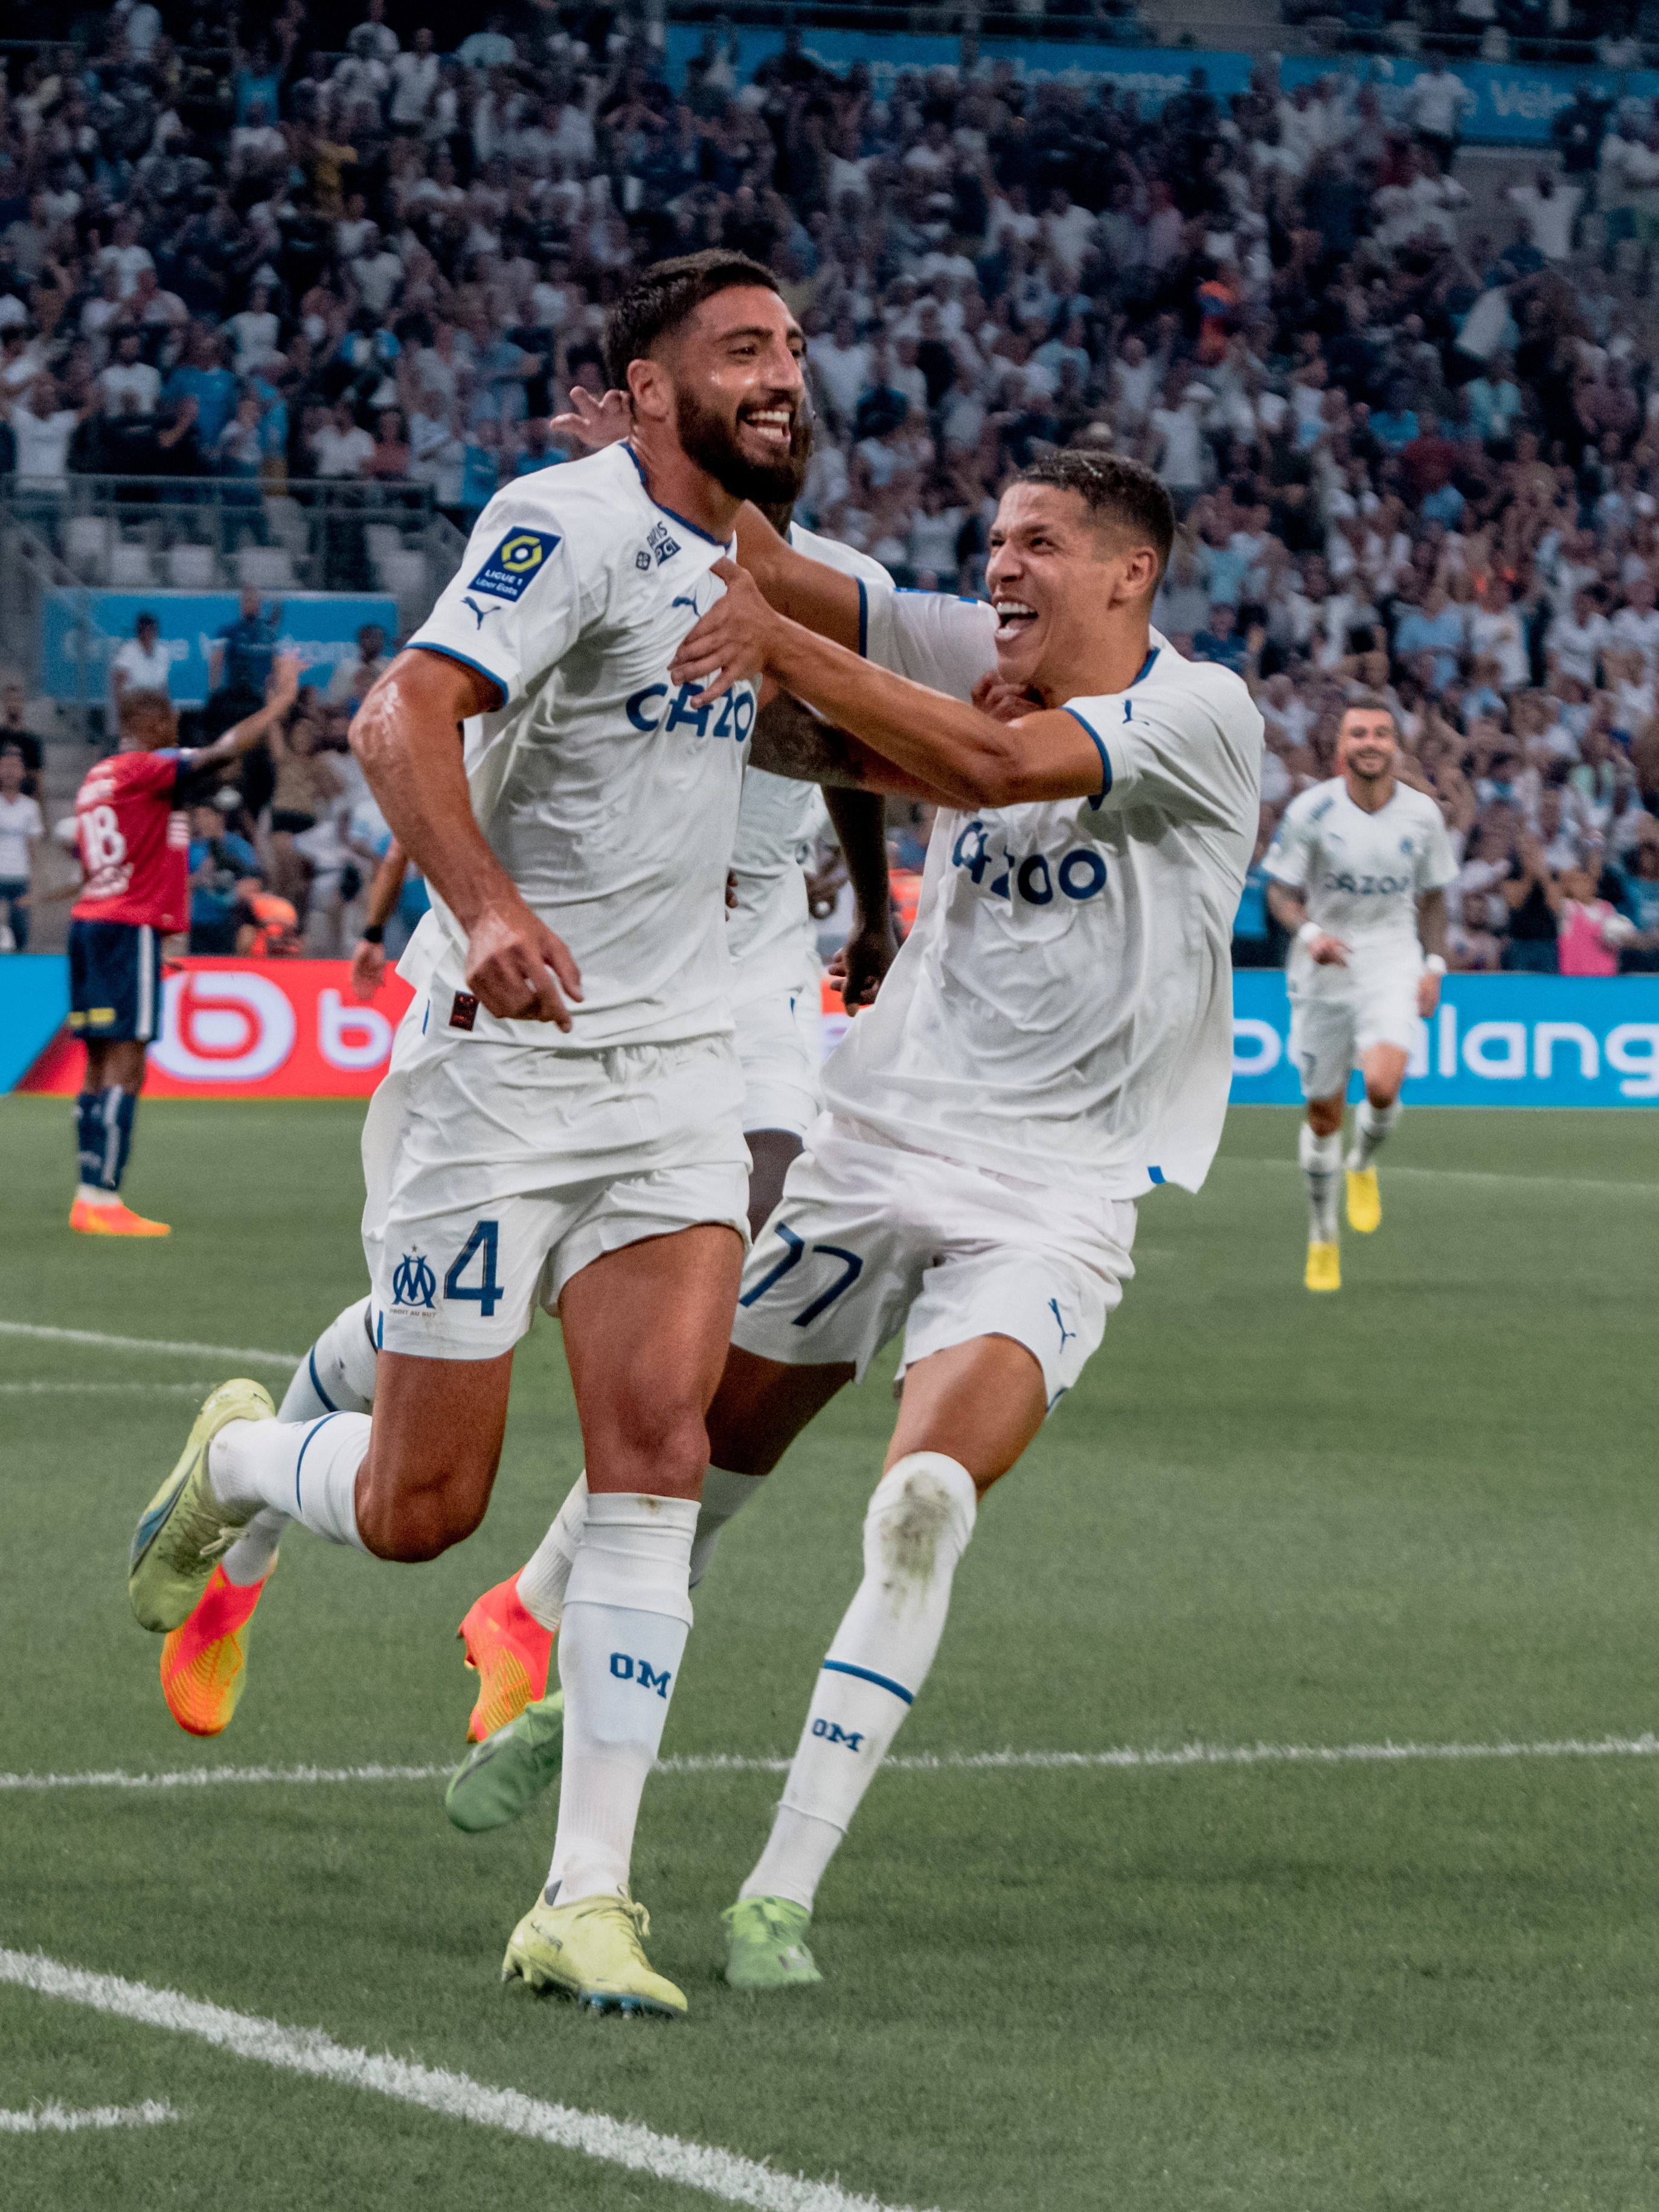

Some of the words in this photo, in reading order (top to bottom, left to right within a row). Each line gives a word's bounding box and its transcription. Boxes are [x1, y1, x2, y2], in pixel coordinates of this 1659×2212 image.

[475, 577, 496, 588] Uber
[496, 582, 518, 596] Eats
[484, 569, 516, 584] LIGUE
[79, 805, 127, 870] 18
[443, 1220, 504, 1317] 4
[610, 1652, 671, 1699] OM
[812, 1718, 864, 1752] OM
